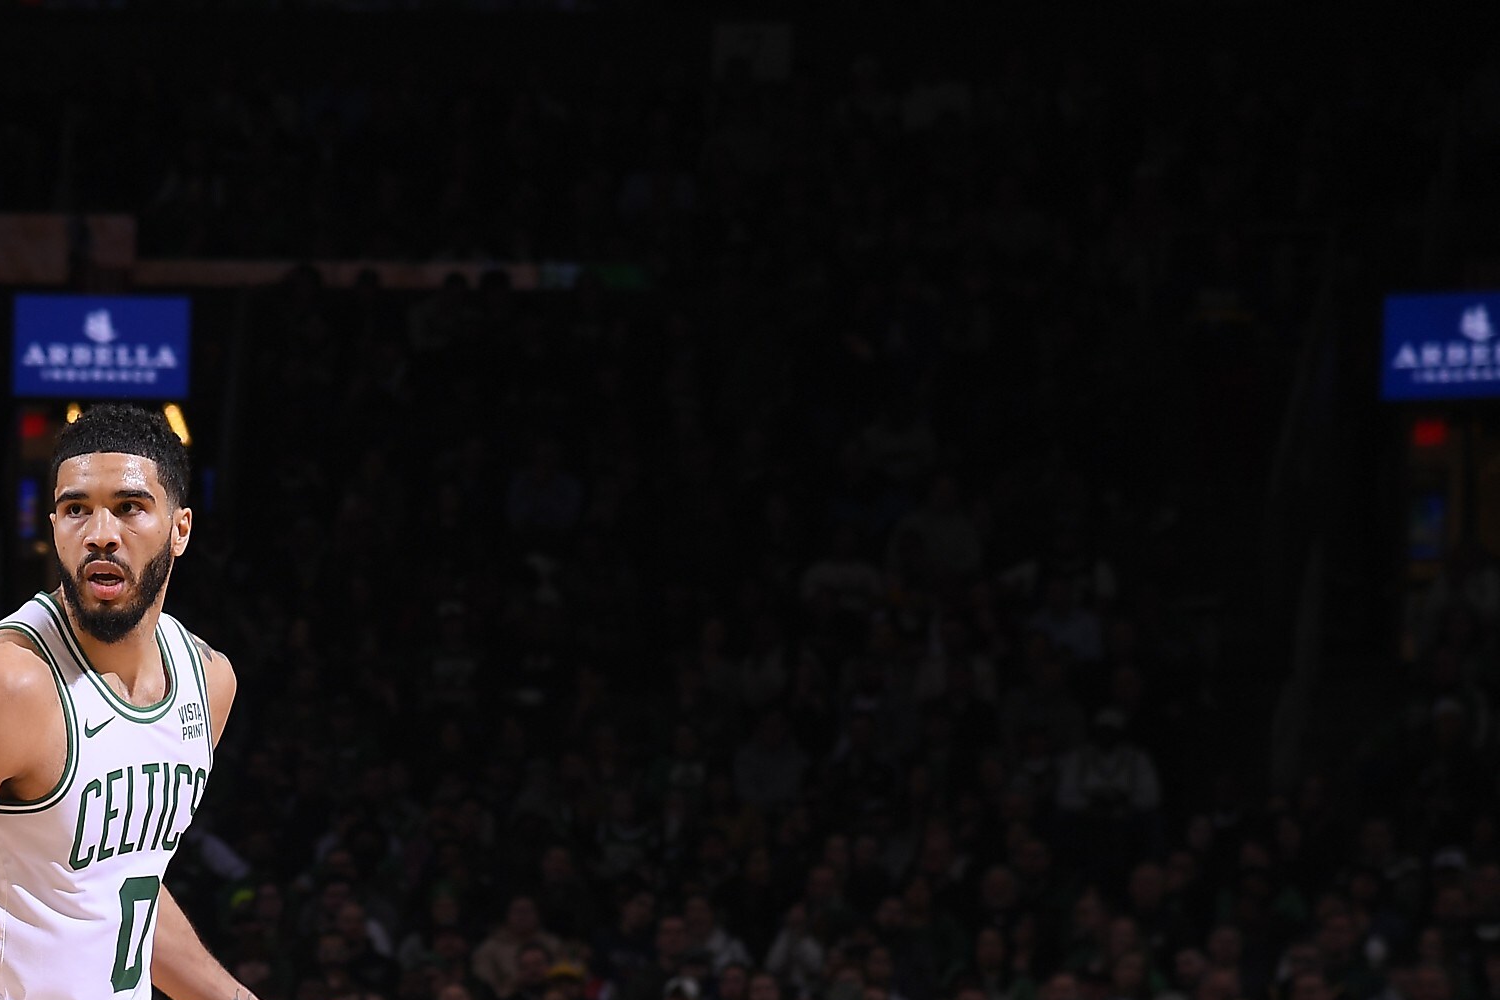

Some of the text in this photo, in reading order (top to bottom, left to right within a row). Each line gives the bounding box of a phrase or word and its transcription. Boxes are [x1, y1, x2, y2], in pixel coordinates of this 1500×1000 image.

[178, 702, 203, 724] VISTA
[182, 723, 204, 741] PRINT
[111, 875, 160, 993] 0
